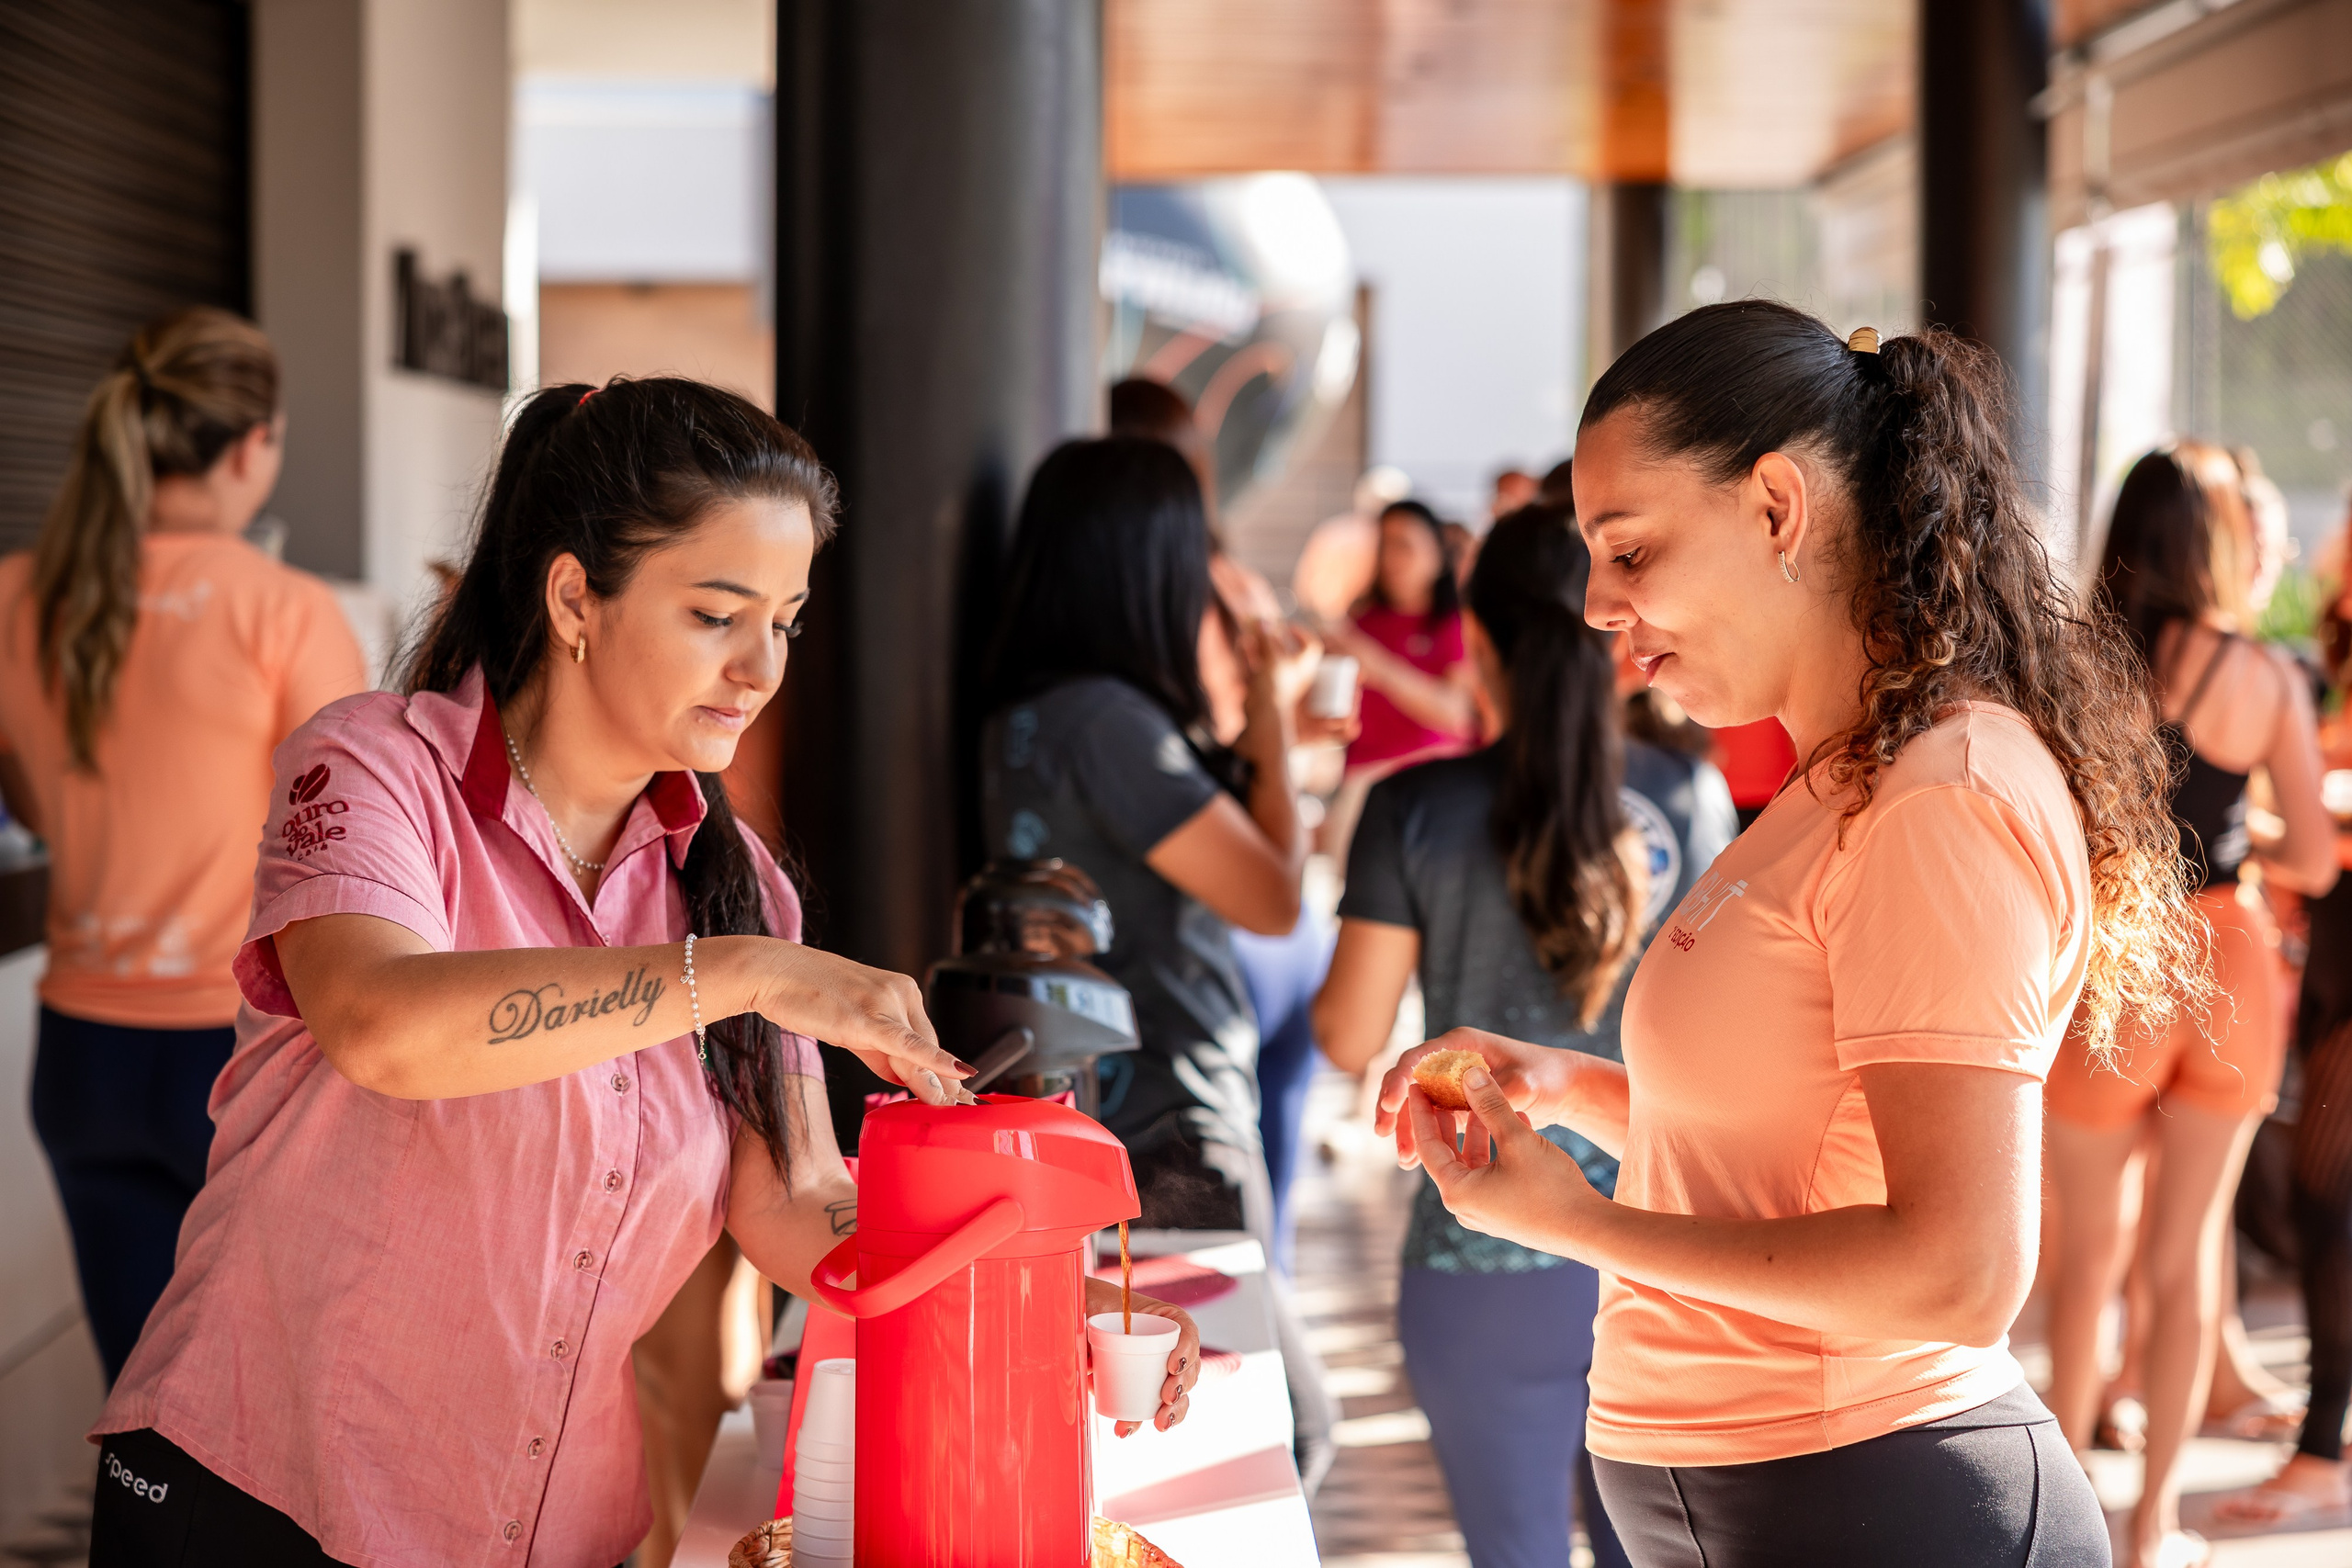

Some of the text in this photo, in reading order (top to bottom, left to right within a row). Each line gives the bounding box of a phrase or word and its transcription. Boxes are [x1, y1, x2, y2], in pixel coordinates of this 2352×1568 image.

[282, 800, 349, 838] ouro
[286, 820, 346, 857] vale
[488, 967, 666, 1045] Darielly
[105, 1452, 169, 1504] speed
